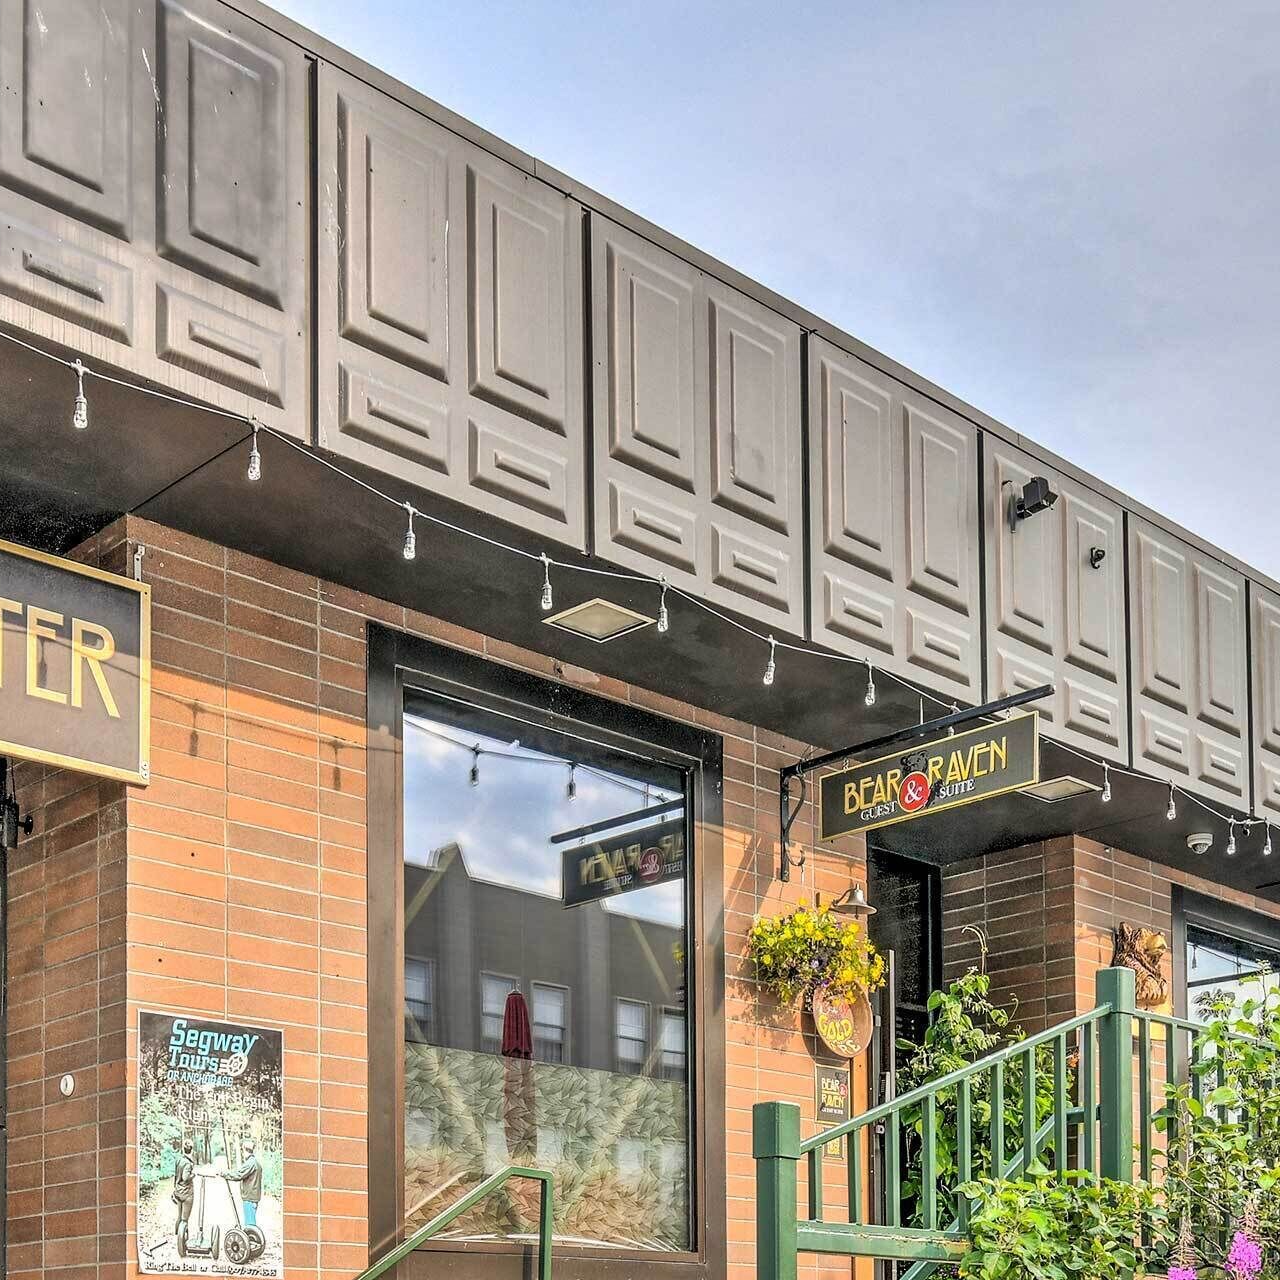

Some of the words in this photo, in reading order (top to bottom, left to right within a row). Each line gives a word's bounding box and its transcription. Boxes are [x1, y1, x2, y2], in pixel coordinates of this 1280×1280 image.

[844, 768, 902, 814] BEAR
[905, 780, 923, 804] &
[928, 736, 1007, 787] RAVEN
[861, 800, 898, 821] GUEST
[939, 778, 976, 799] SUITE
[170, 1019, 259, 1057] Segway
[168, 1045, 219, 1072] Tours
[821, 1077, 840, 1092] BEAR
[821, 1092, 845, 1108] RAVEN
